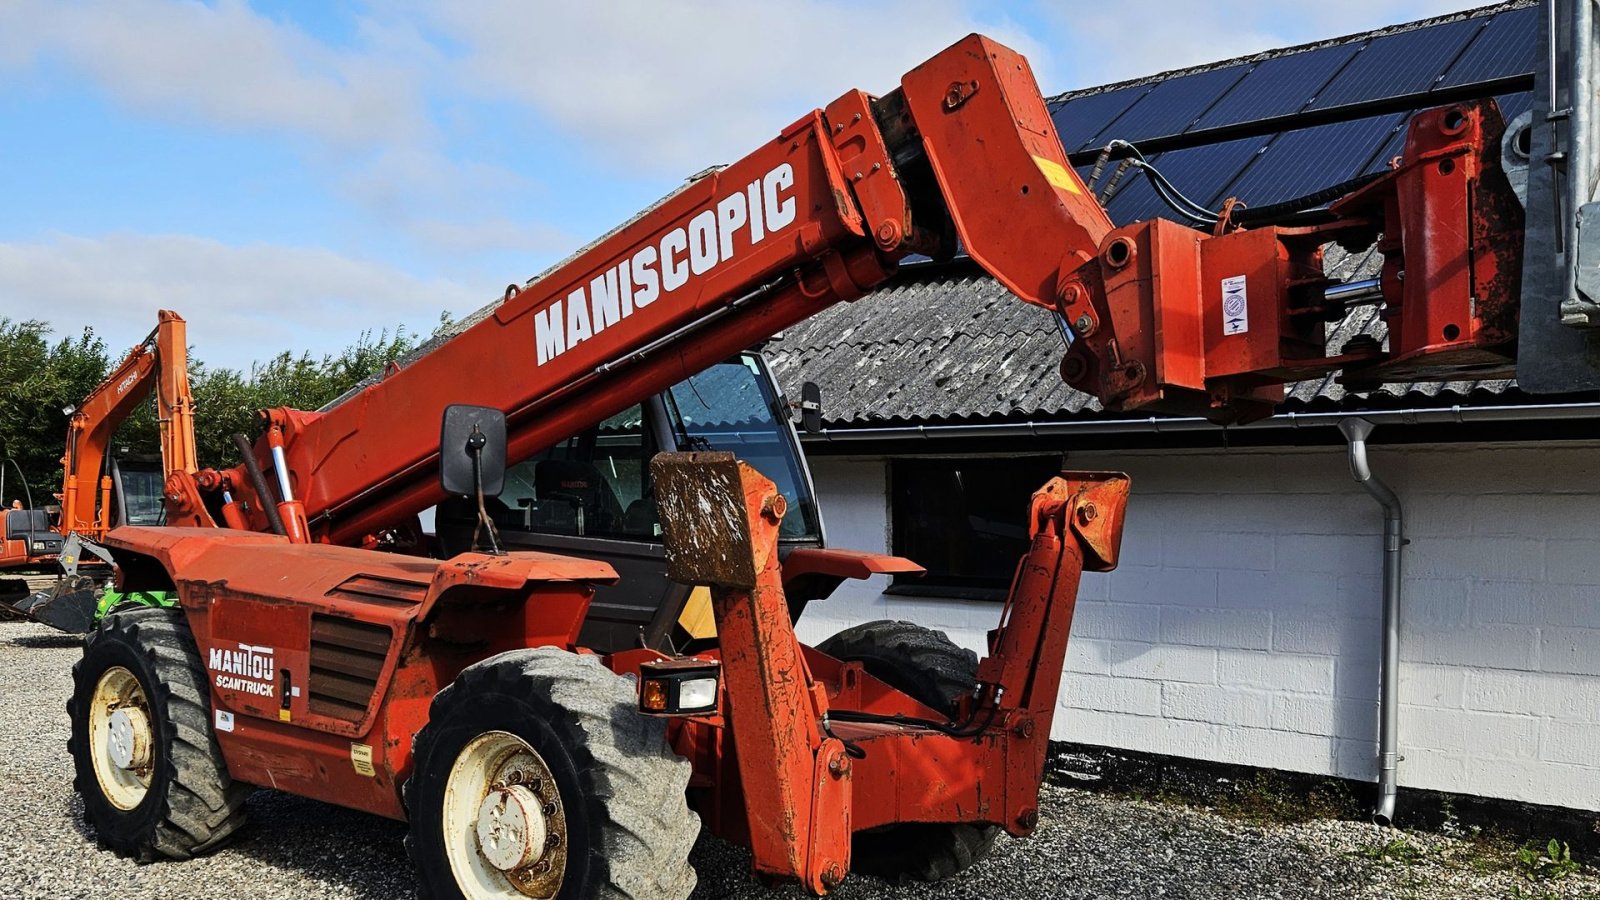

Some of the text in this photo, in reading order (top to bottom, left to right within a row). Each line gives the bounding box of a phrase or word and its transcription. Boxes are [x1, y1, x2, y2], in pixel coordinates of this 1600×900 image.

[534, 162, 797, 367] MANISCOPIC
[208, 642, 274, 681] MANITOU
[215, 675, 275, 698] SCANTRUCK
